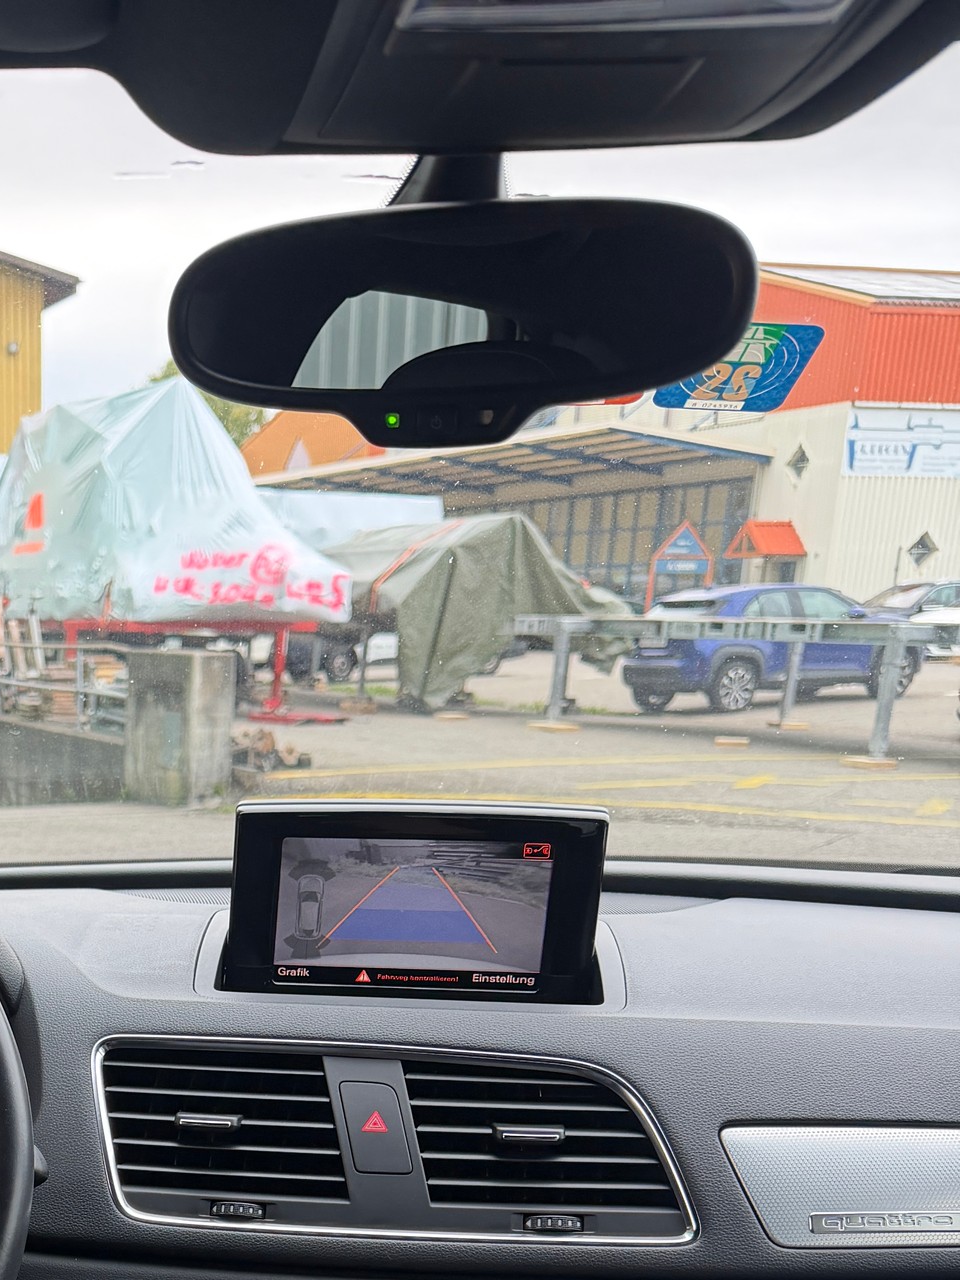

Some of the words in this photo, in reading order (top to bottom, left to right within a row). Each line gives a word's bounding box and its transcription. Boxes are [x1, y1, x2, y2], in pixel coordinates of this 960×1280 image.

[277, 966, 310, 979] Grafik
[472, 973, 535, 986] Einstellung
[822, 1213, 954, 1231] quattro
